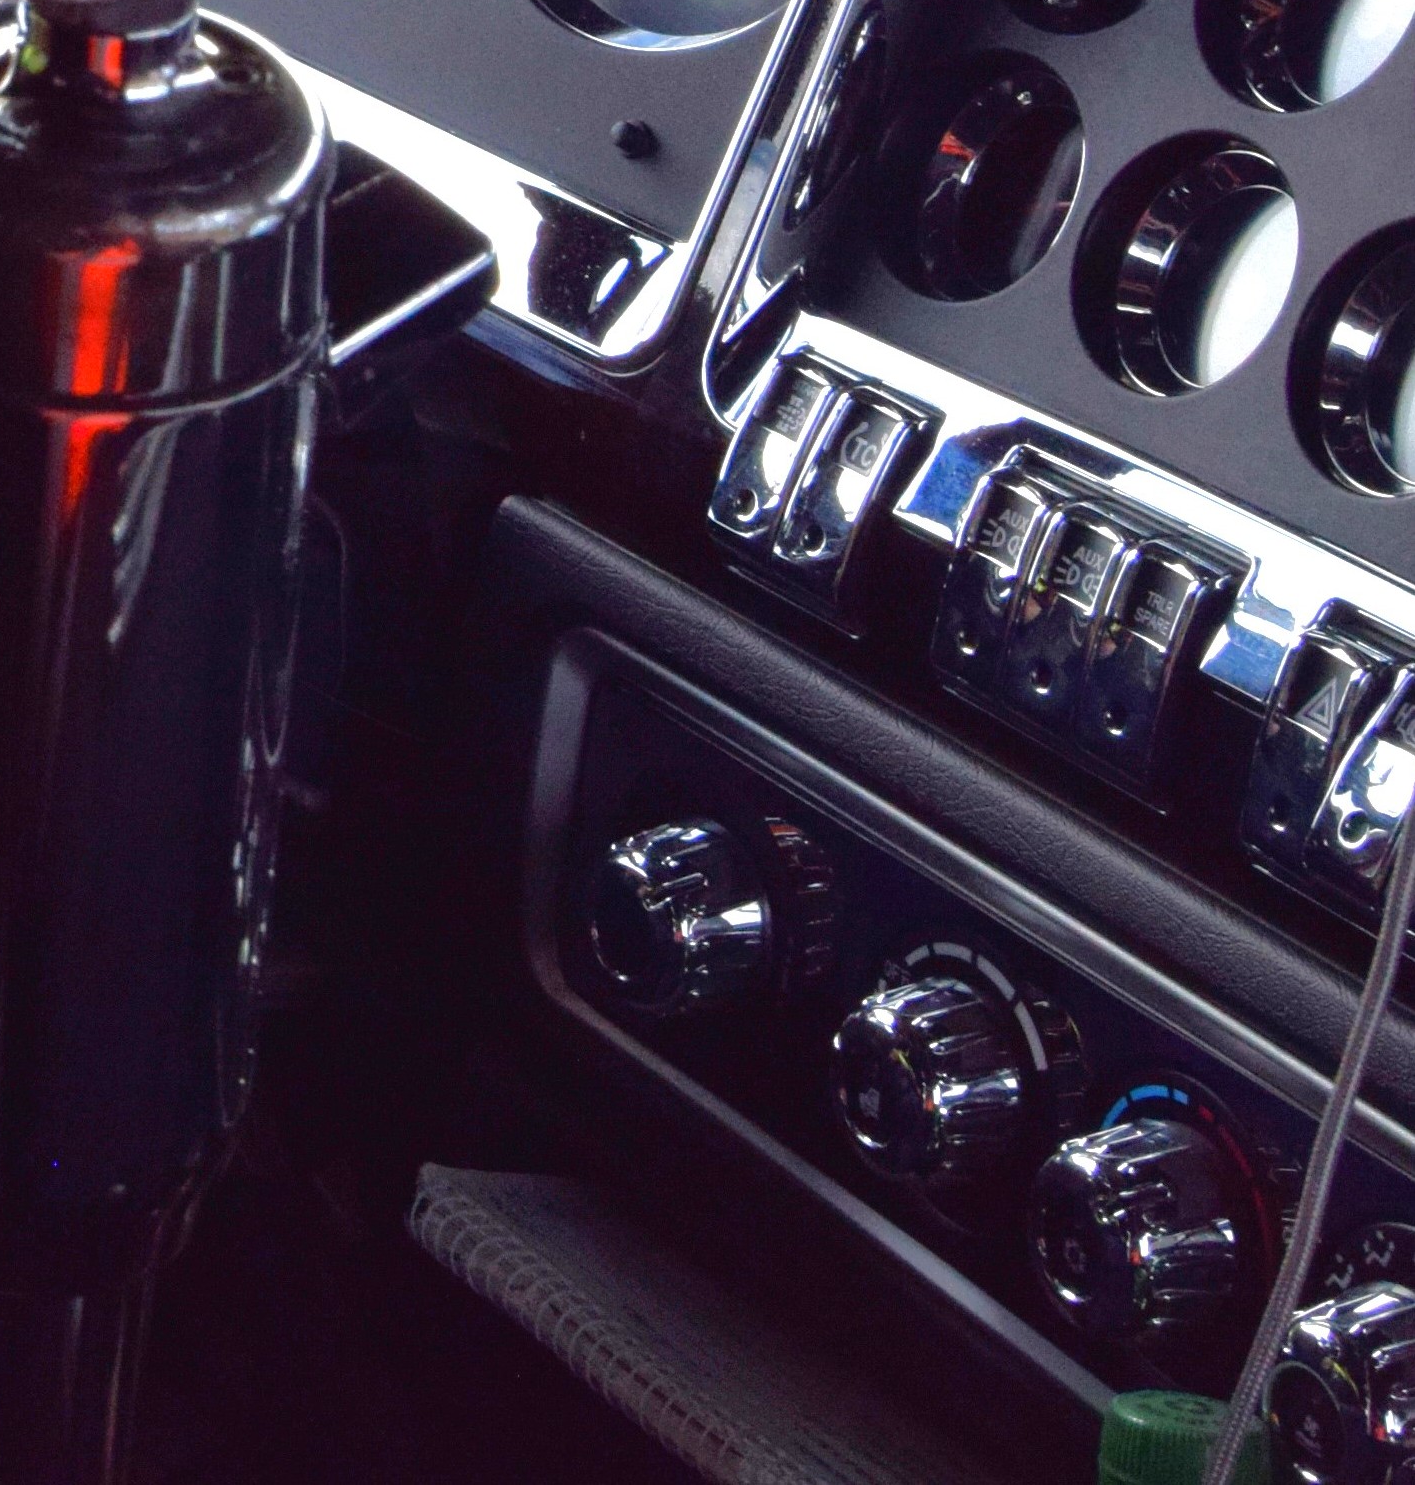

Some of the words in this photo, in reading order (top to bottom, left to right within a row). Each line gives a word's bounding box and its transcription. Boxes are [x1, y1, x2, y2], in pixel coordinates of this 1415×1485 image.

[850, 436, 879, 468] TC
[999, 509, 1030, 534] AUX
[1073, 546, 1107, 570] AUX
[1133, 609, 1173, 637] SPARE
